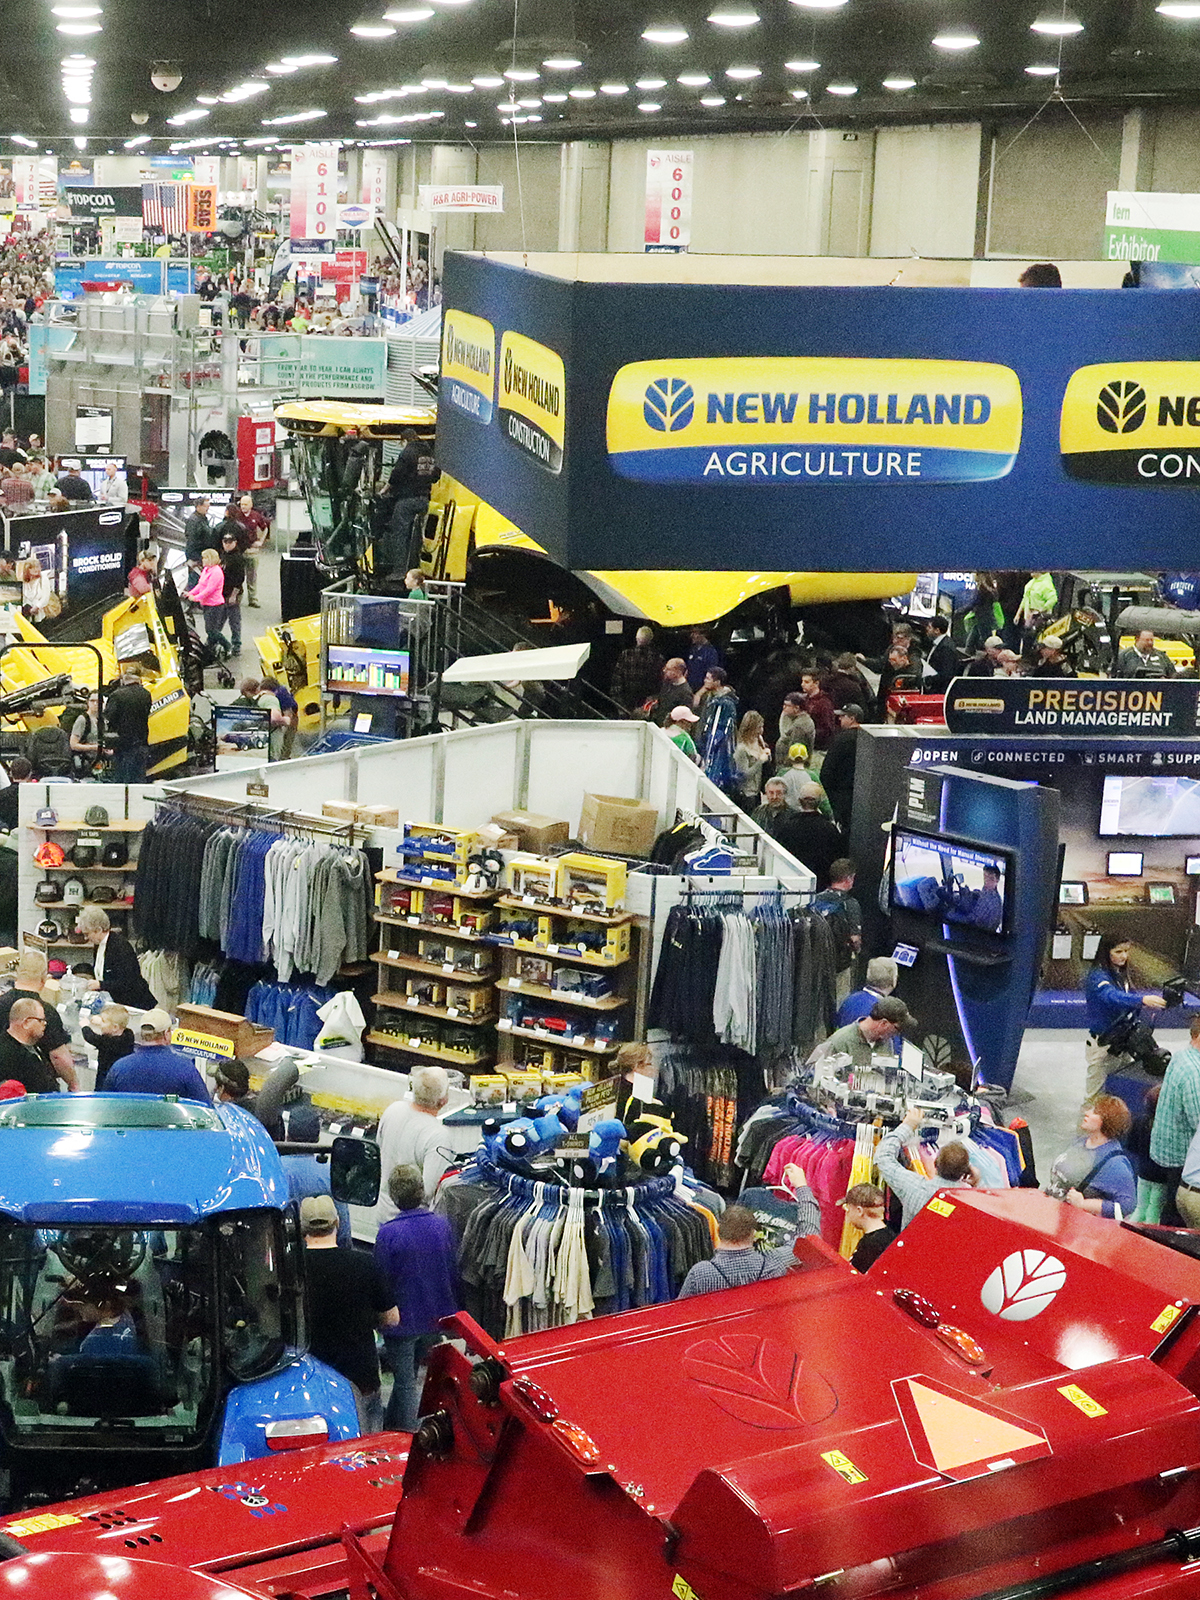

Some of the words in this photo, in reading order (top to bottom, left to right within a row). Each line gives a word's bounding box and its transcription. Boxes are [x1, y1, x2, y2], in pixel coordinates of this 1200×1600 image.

[310, 149, 336, 159] AISLE
[666, 155, 692, 163] AISLE
[72, 194, 115, 206] TOPCON
[316, 163, 328, 234] 6100
[433, 194, 449, 206] H&R
[451, 192, 498, 206] AGRI-POWER
[670, 168, 683, 239] 6000
[199, 190, 212, 227] SCAG
[1113, 203, 1131, 220] fern
[1108, 234, 1161, 261] Exhibitor
[454, 338, 465, 364] NEW
[466, 344, 490, 376] HOLLAND
[513, 363, 528, 399] NEW
[528, 372, 560, 417] HOLLAND
[452, 384, 481, 416] AGRICULTURE
[707, 392, 800, 425] NEW
[807, 393, 991, 425] HOLLAND
[508, 415, 551, 462] CONSTRUCTION
[703, 452, 922, 477] AGRICULTURE
[73, 555, 99, 567] BROCK
[100, 552, 122, 566] SOLID
[78, 561, 121, 573] CONDITIONING
[1029, 690, 1162, 711] PRECISION
[1015, 711, 1057, 725] LAND
[1061, 712, 1173, 727] MANAGEMENT
[924, 751, 958, 762] OPEN
[988, 752, 1065, 763] CONNECTED
[1098, 753, 1142, 764] SMART
[909, 777, 925, 809] PLM
[186, 1036, 199, 1045] NEW
[200, 1039, 229, 1052] HOLLAND
